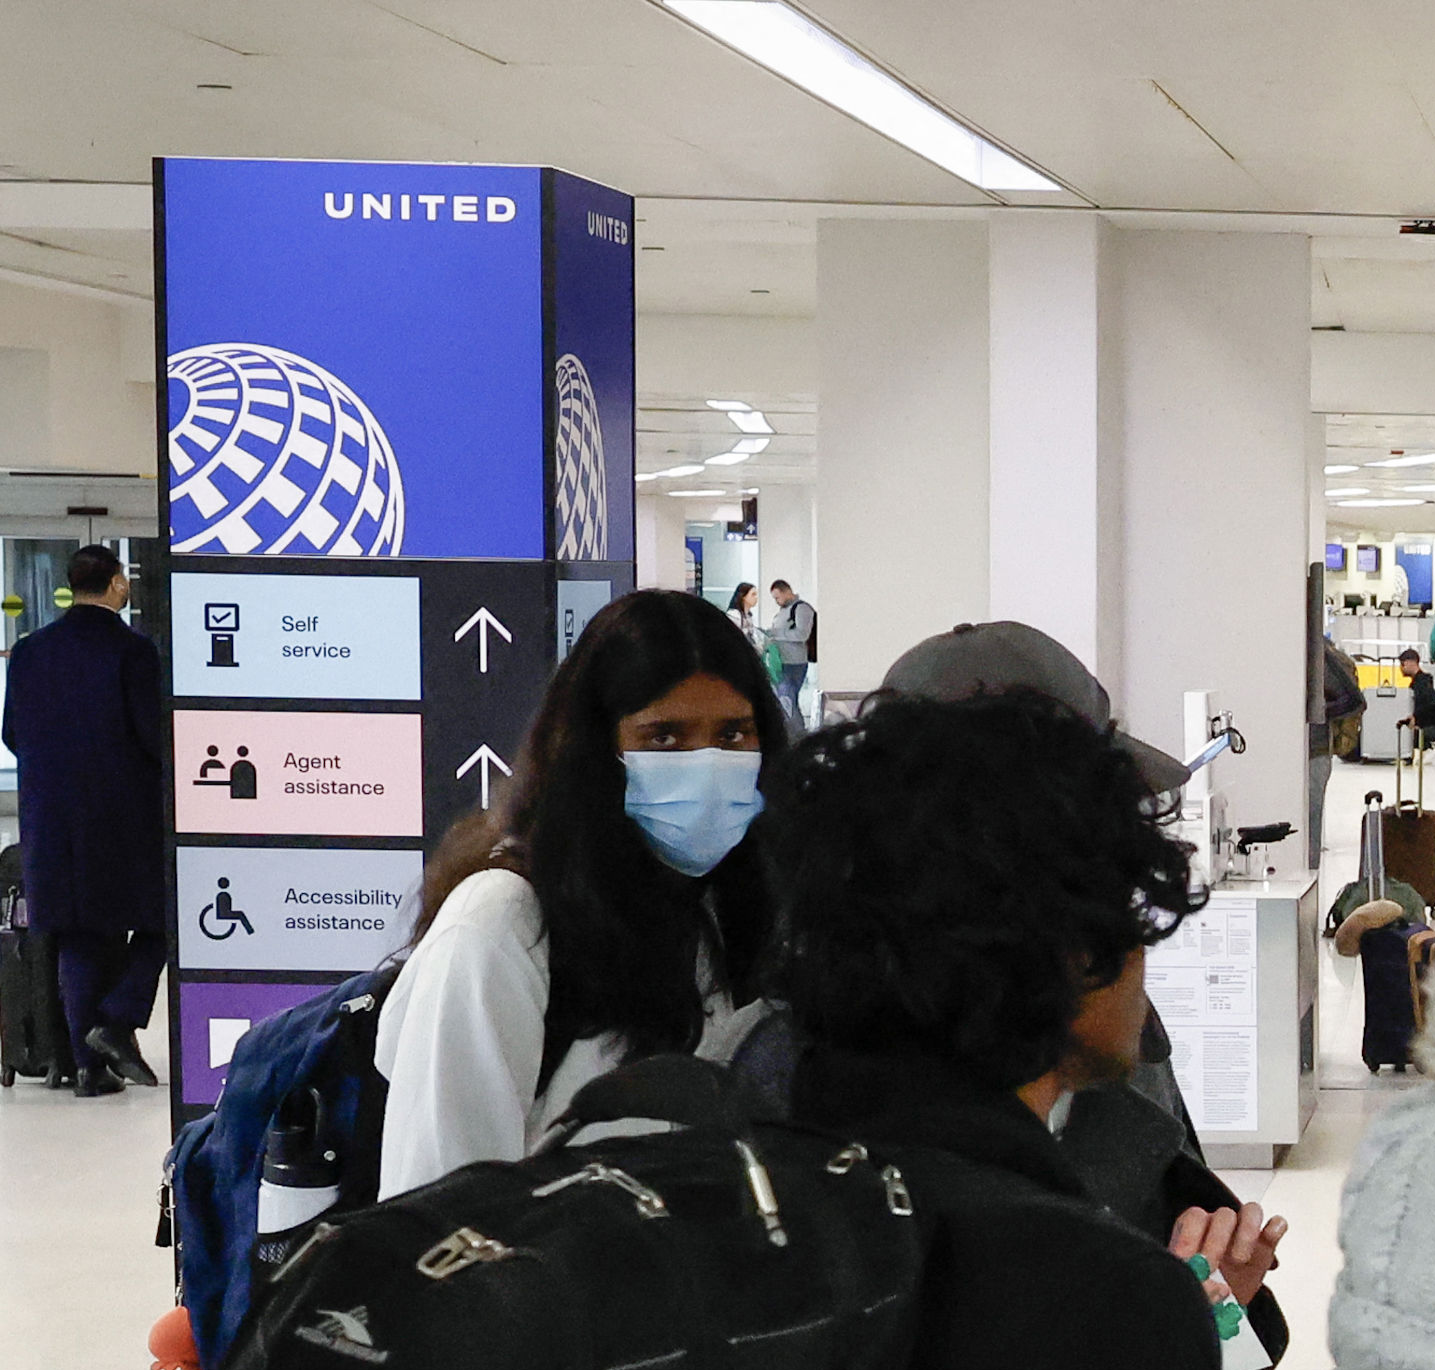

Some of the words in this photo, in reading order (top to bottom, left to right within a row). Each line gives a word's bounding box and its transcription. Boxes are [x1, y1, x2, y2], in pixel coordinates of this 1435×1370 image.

[324, 192, 517, 223] UNITED
[587, 210, 628, 246] UNITED
[281, 615, 319, 633] Self
[281, 642, 351, 658] service
[283, 752, 342, 773] Agent
[284, 779, 385, 796] assistance
[284, 887, 403, 909] Accessibility
[284, 914, 386, 931] assistance
